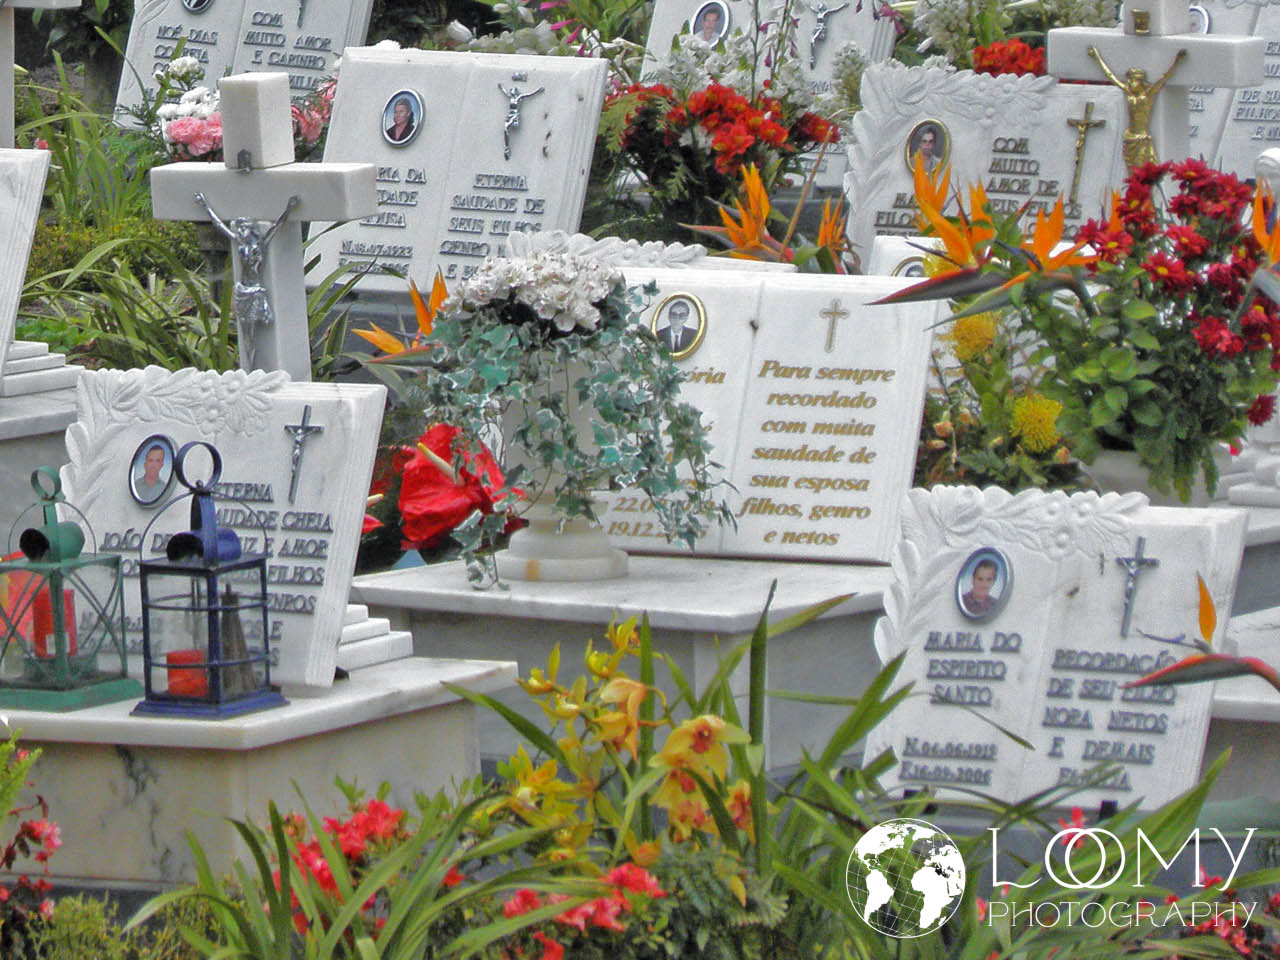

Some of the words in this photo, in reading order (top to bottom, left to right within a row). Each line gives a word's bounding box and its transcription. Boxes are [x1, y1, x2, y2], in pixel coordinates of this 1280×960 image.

[992, 137, 1030, 154] COM
[988, 158, 1040, 175] MUITO
[473, 174, 529, 191] ETERNA
[985, 177, 1031, 195] AMOR
[1035, 180, 1059, 197] DE
[450, 195, 519, 213] SAUDADE
[523, 199, 545, 215] DE
[758, 360, 813, 379] Para
[815, 367, 896, 385] sempre
[767, 390, 877, 410] recordado
[760, 419, 807, 434] com
[811, 419, 876, 437] muita
[752, 444, 845, 463] saudade
[848, 445, 877, 464] de
[749, 474, 791, 489] sua
[794, 477, 871, 495] esposa
[735, 496, 804, 519] filhos,
[808, 505, 871, 521] genro
[280, 511, 334, 534] CHEIA
[763, 530, 777, 543] e
[781, 529, 840, 546] netos
[278, 539, 329, 558] AMOR
[267, 565, 325, 586] FILHOS
[923, 632, 984, 652] MARIA
[990, 632, 1021, 653] DO
[926, 659, 1007, 681] ESPIRITO
[929, 684, 994, 707] SANTO
[1047, 678, 1075, 699] DE
[1078, 679, 1117, 701] SEU
[1042, 707, 1093, 729] NORA
[1108, 711, 1168, 734] NETOS
[1048, 737, 1065, 757] E
[1082, 741, 1155, 765] DEMAIS
